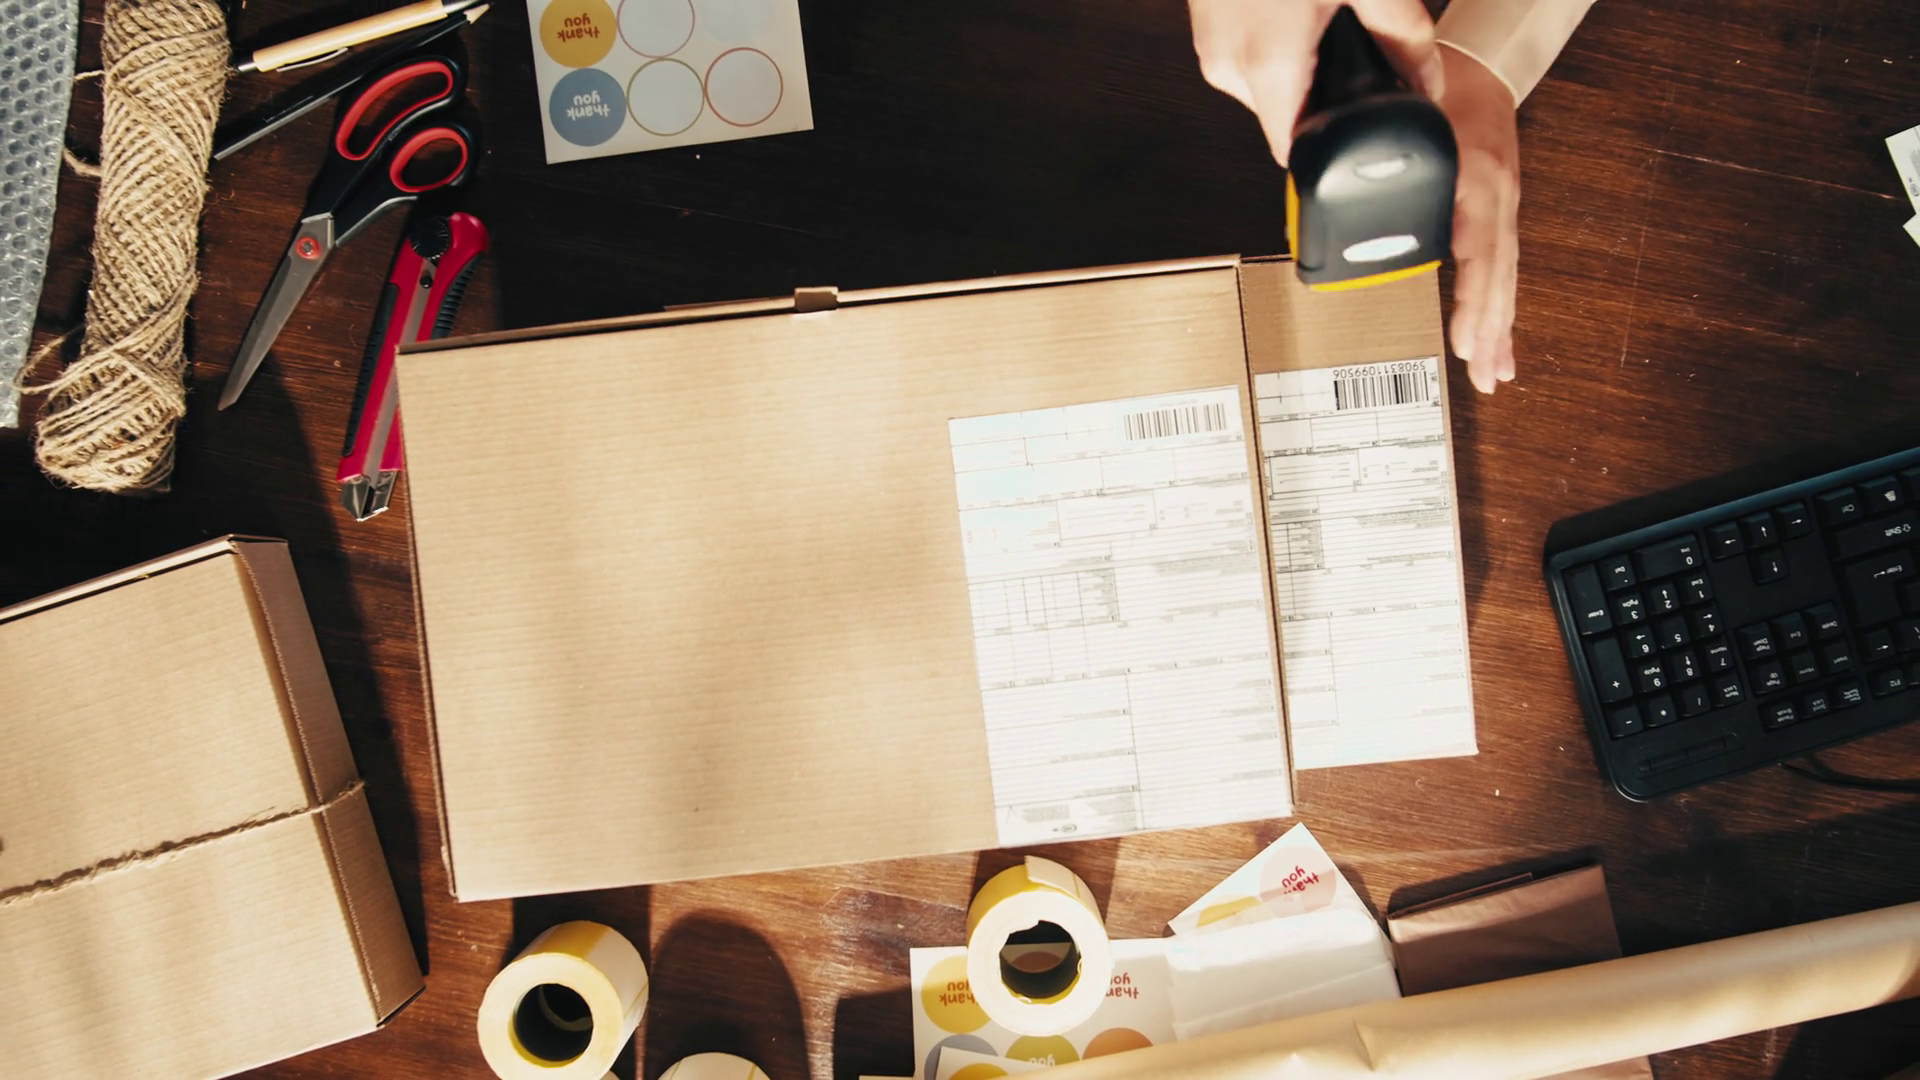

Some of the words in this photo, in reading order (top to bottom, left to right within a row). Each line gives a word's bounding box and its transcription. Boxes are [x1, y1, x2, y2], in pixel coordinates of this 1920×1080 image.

[563, 13, 591, 28] you
[557, 26, 600, 43] thank
[573, 90, 601, 106] you
[566, 103, 610, 121] thank
[1333, 361, 1426, 380] 5908311099506
[1884, 526, 1902, 537] Shift
[1686, 556, 1693, 565] 0
[1699, 590, 1705, 598] 1
[1664, 600, 1672, 609] 2
[1631, 610, 1639, 619] 3
[1708, 624, 1715, 632] 4
[1674, 633, 1682, 642] 5
[1641, 644, 1649, 653] 6
[1721, 658, 1727, 666] 7
[1686, 667, 1694, 676] 8
[1653, 678, 1661, 687] 9
[1282, 866, 1306, 888] you
[1110, 972, 1131, 985] yo
[1105, 987, 1139, 1000] than
[939, 993, 975, 1007] hank
